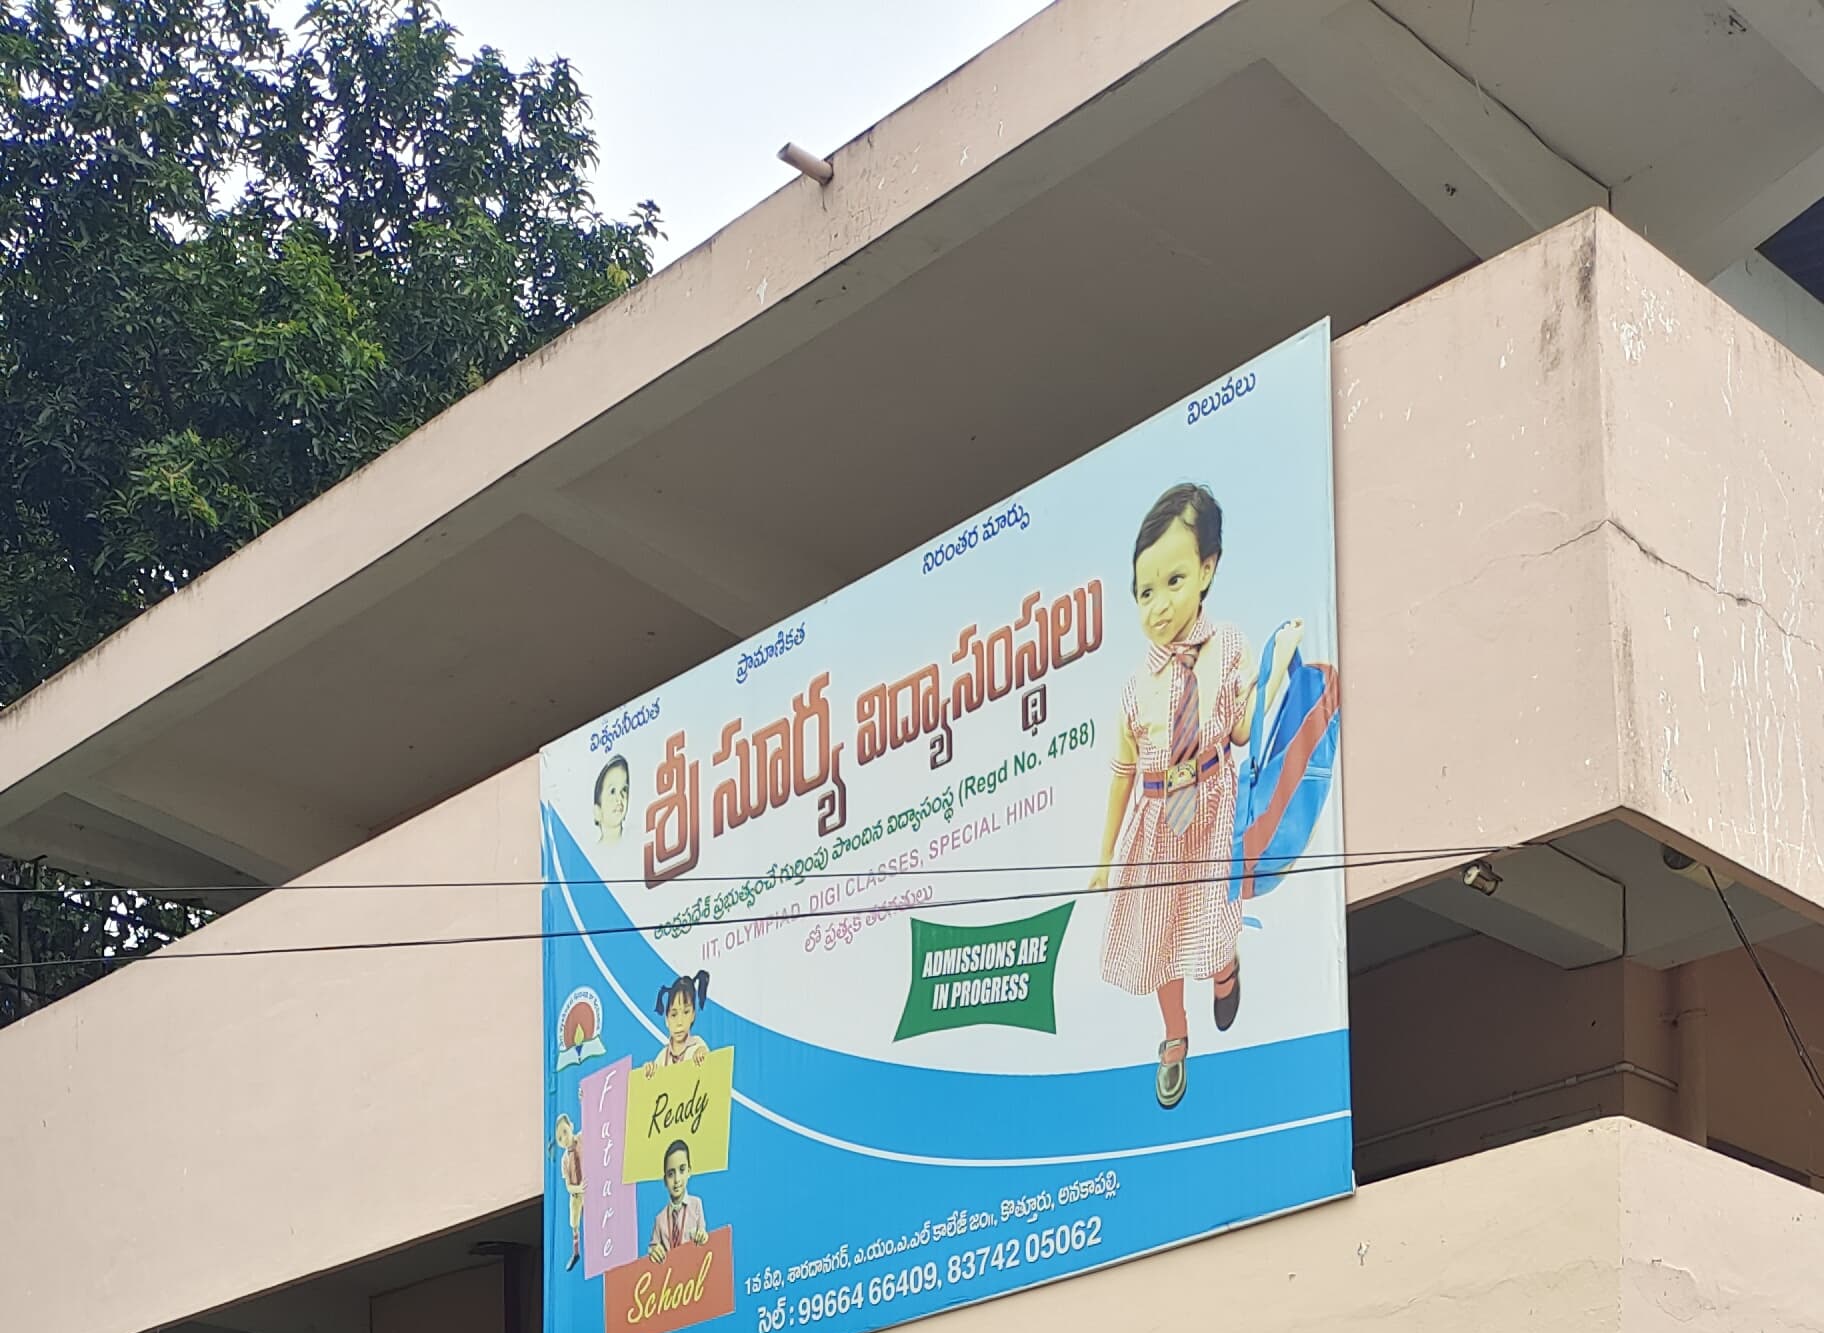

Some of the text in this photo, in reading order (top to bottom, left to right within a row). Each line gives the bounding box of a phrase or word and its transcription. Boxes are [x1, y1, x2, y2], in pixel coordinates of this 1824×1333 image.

[1187, 372, 1256, 425] విలువలు
[922, 503, 1030, 574] నిరంతర మార్పు
[736, 621, 805, 684] ప్రామాణికత
[643, 579, 1103, 890] శ్రీ సూర్య విద్యాసంస్థలు
[887, 785, 955, 833] విద్యాసంస్థ
[958, 760, 1008, 807] (Regd
[1013, 750, 1042, 777] No.
[1047, 718, 1096, 759] 4788)
[702, 937, 721, 961] IIT,
[809, 883, 841, 913] DIGI
[845, 849, 924, 897] CLASSES,
[928, 812, 1001, 860] SPECIAL
[1006, 787, 1054, 825] HINDI
[805, 924, 822, 952] లో
[922, 935, 1049, 979] ADMISSIONS ARE
[932, 972, 1030, 1010] IN PROGRESS
[648, 1079, 709, 1139] Ready
[626, 1250, 714, 1324] School
[798, 1281, 864, 1325] 99664
[868, 1261, 943, 1305] 66409,
[947, 1239, 1021, 1285] 83742
[1025, 1215, 1102, 1263] 05062
